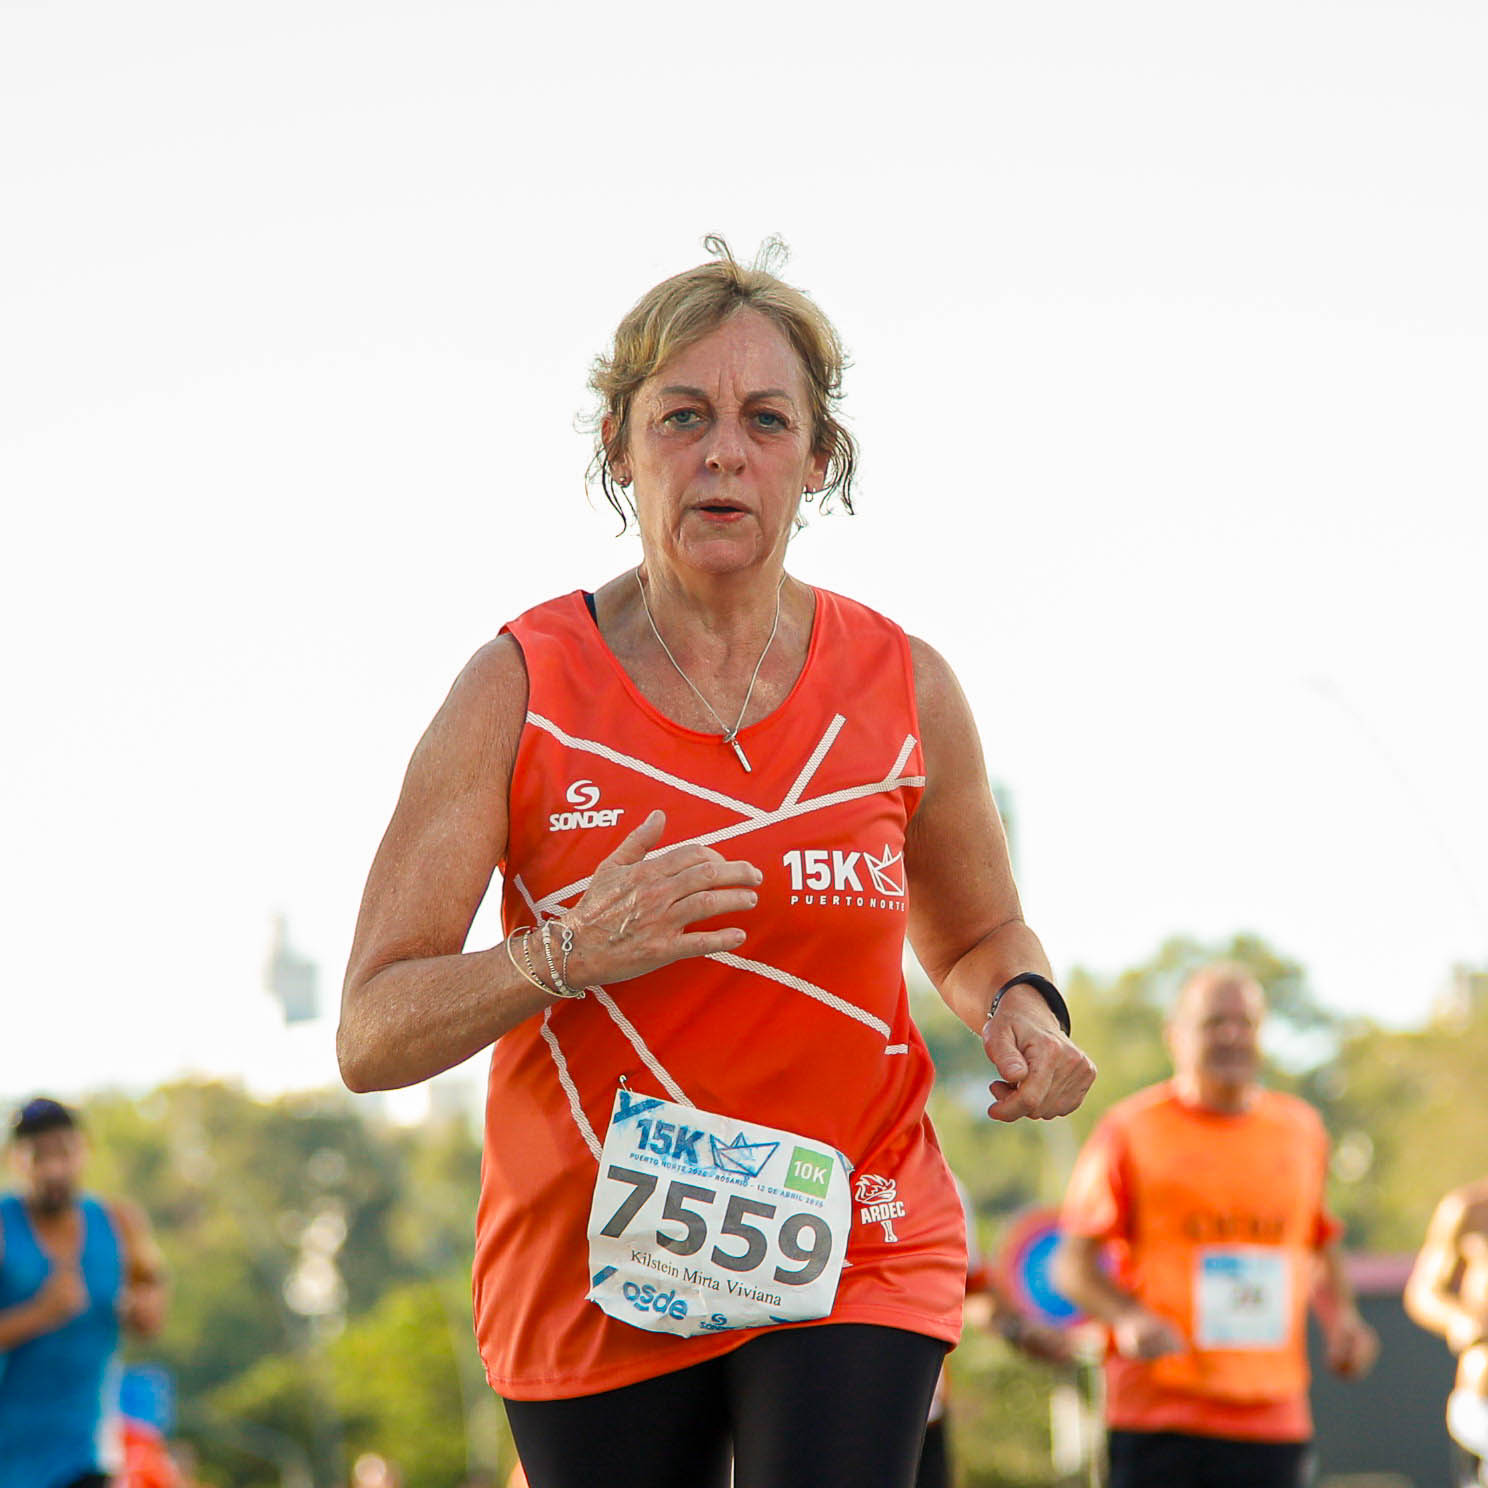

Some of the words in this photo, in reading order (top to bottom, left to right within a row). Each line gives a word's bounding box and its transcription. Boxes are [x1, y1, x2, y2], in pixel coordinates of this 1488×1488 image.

[782, 849, 864, 892] 15K
[790, 895, 864, 907] PUERTO
[869, 898, 905, 912] NORTE
[636, 1118, 706, 1165] 15K
[629, 1152, 659, 1165] PUERTO
[661, 1160, 687, 1172] NORTE
[714, 1174, 749, 1187] ROSARIO
[779, 1190, 804, 1201] ABRIL
[794, 1160, 828, 1185] 10K
[599, 1164, 833, 1286] 7559
[860, 1201, 906, 1225] ARDEC
[631, 1249, 679, 1277] Kilstein
[682, 1268, 720, 1291] Mirta
[726, 1279, 782, 1306] Viviana
[623, 1281, 688, 1321] osde
